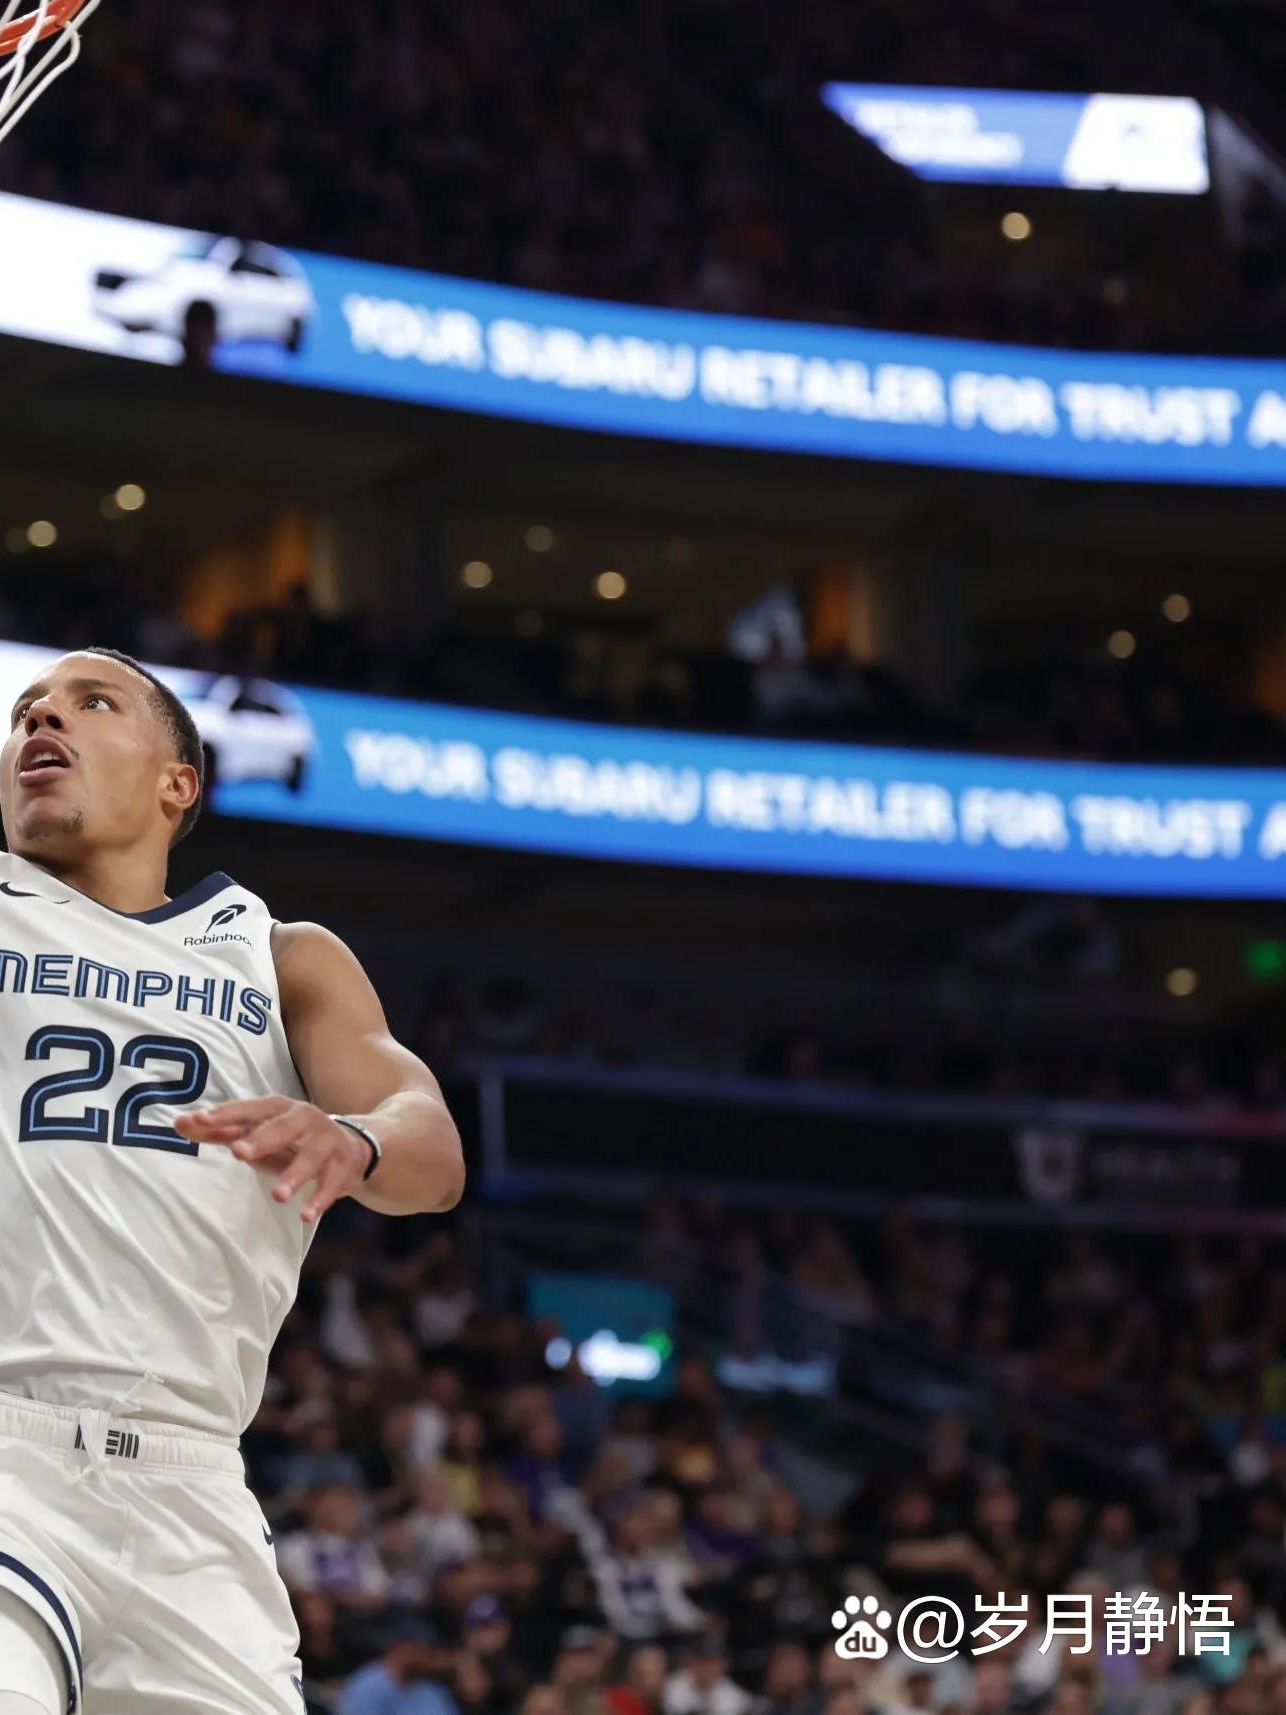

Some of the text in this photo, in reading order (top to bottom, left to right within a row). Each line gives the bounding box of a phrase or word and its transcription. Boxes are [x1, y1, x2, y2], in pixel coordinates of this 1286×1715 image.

[342, 293, 485, 372] YOUR
[487, 318, 696, 400] SUBARU
[700, 345, 946, 428] RETAILER
[949, 371, 1059, 438] FOR
[1062, 381, 1241, 447] TRUST
[344, 727, 489, 803] YOUR
[492, 747, 701, 825] SUBARU
[705, 769, 956, 845] RETAILER
[959, 786, 1069, 852] FOR
[1072, 794, 1252, 859] TRUST
[183, 932, 252, 947] Robinhoo
[19, 1024, 210, 1157] 22
